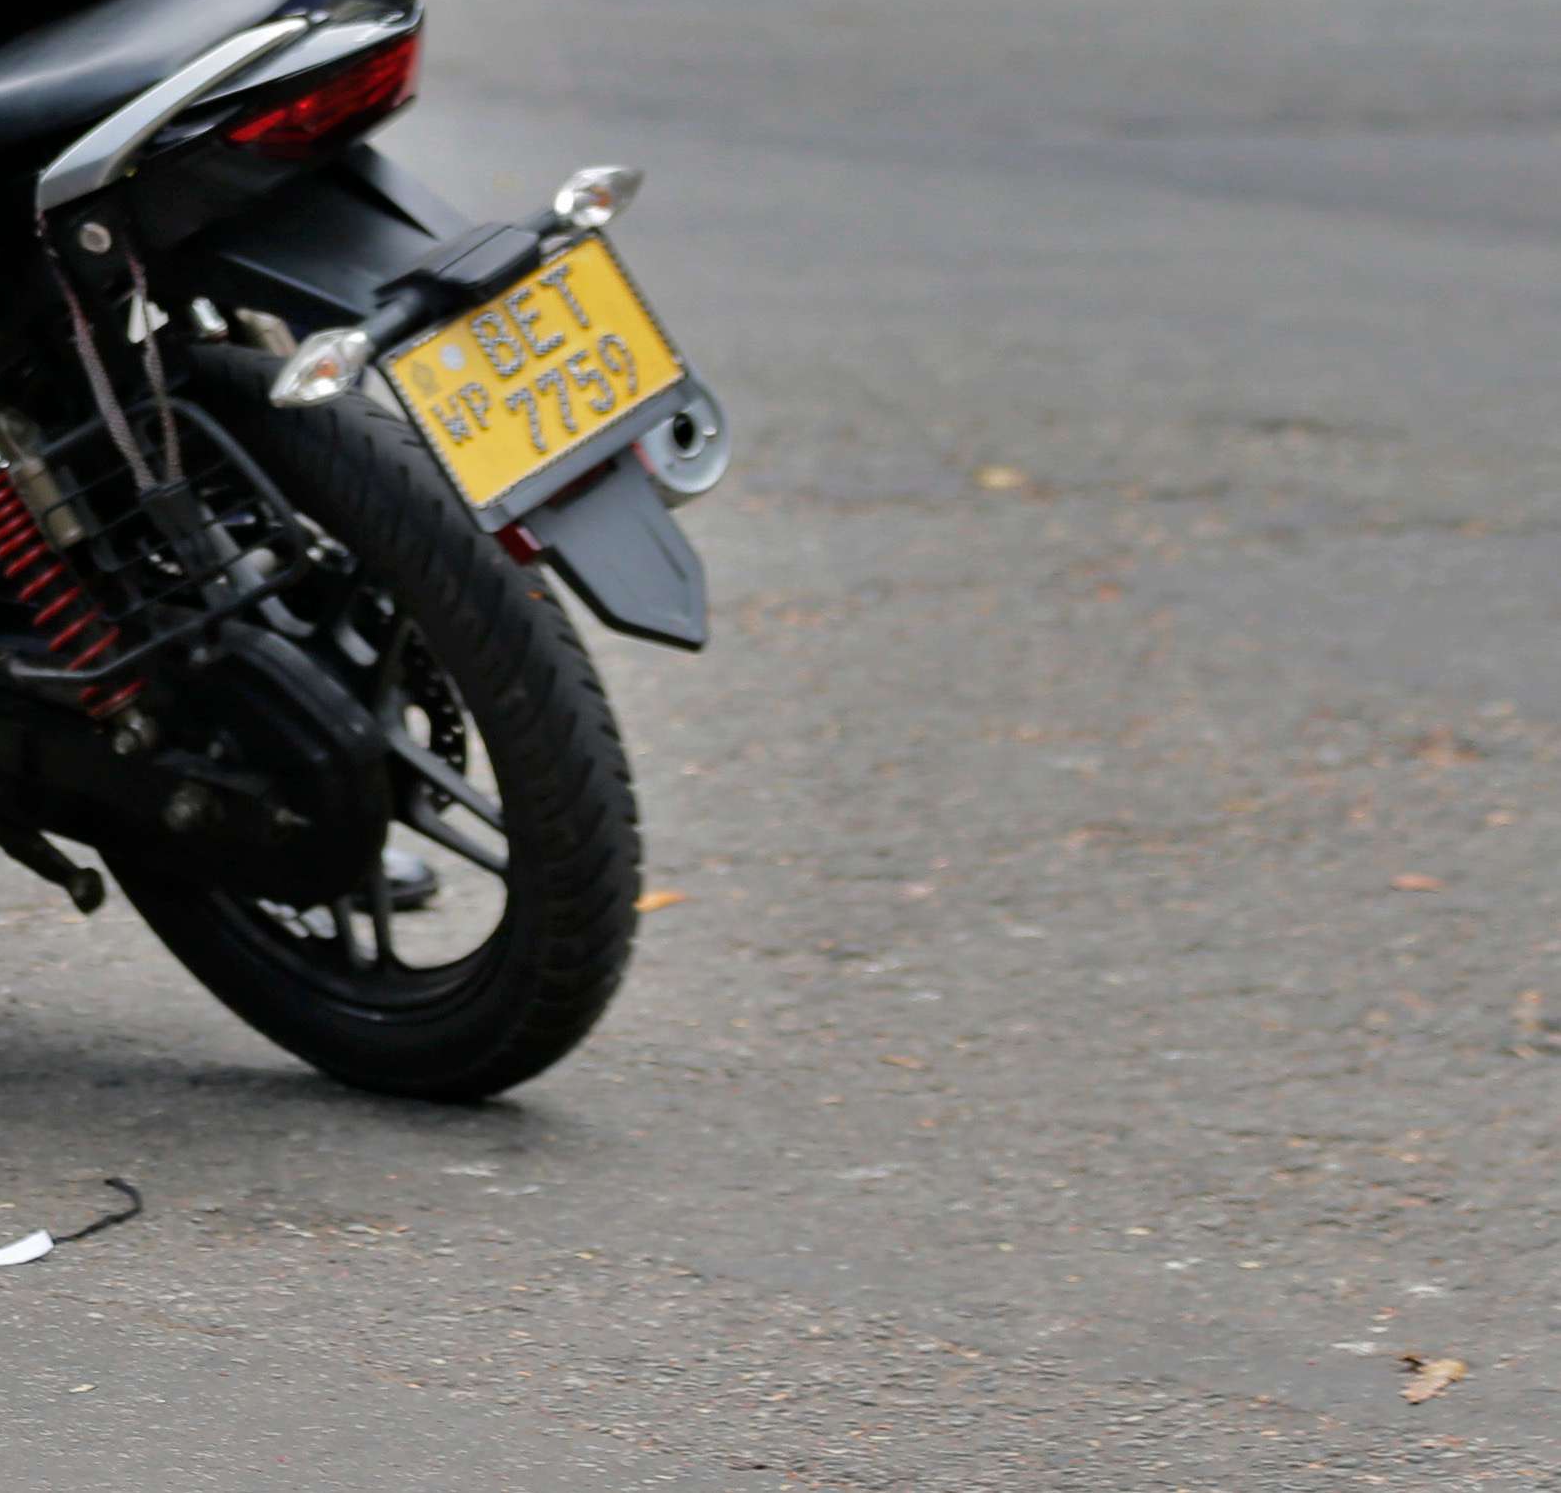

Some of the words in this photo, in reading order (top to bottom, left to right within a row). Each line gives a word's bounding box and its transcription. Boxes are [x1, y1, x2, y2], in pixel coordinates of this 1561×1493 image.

[469, 264, 591, 377] BET
[430, 381, 491, 446] WP
[504, 333, 638, 453] 7759
